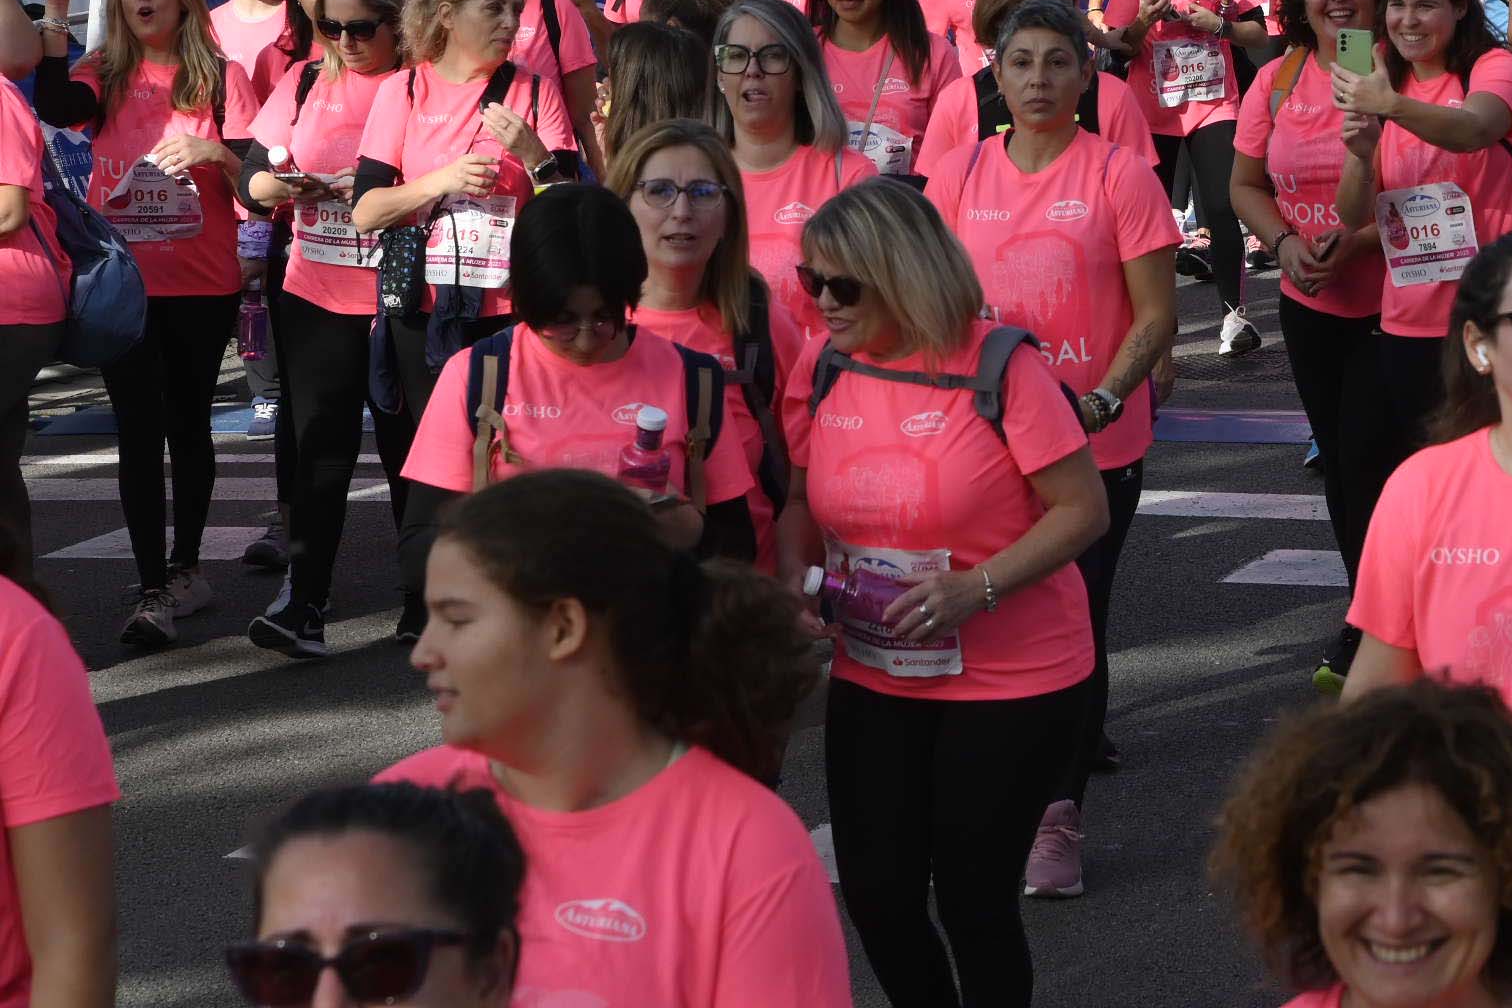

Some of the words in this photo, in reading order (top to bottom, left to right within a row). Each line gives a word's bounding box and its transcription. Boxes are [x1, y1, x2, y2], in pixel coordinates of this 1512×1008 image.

[1181, 62, 1205, 74] 016
[134, 189, 168, 202] 016
[137, 205, 164, 214] 20591
[320, 209, 352, 223] 016
[967, 208, 1011, 221] OYSHO
[322, 226, 348, 236] 20209
[446, 228, 479, 242] 016
[1410, 223, 1441, 240] 016
[1418, 242, 1437, 252] 7894
[1039, 337, 1093, 366] SAL
[503, 403, 561, 420] OYSHO
[1430, 547, 1500, 566] OYSHO
[904, 656, 951, 667] Santander
[564, 908, 639, 935] ASTURIANA
